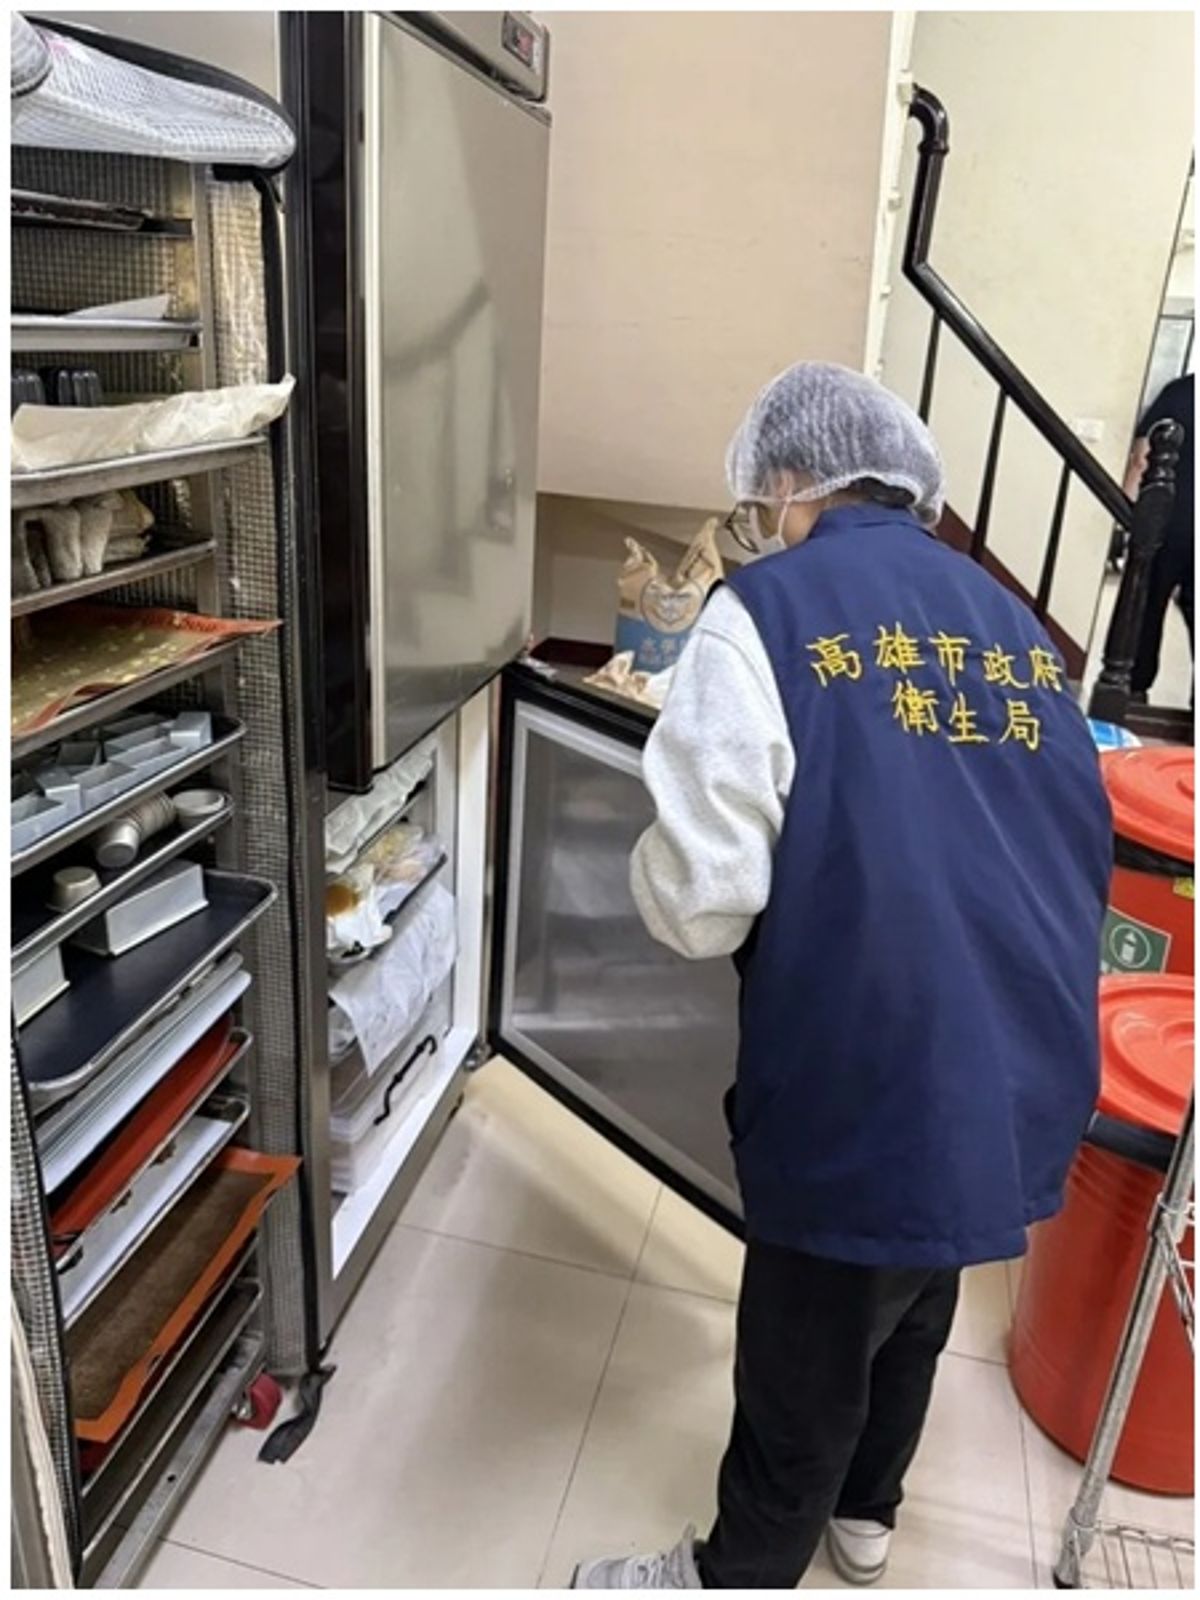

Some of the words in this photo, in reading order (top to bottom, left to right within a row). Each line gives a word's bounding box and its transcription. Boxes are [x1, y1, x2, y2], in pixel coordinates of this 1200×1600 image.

[804, 620, 1063, 693] 高雄市政府
[890, 679, 1041, 751] 衛生局
